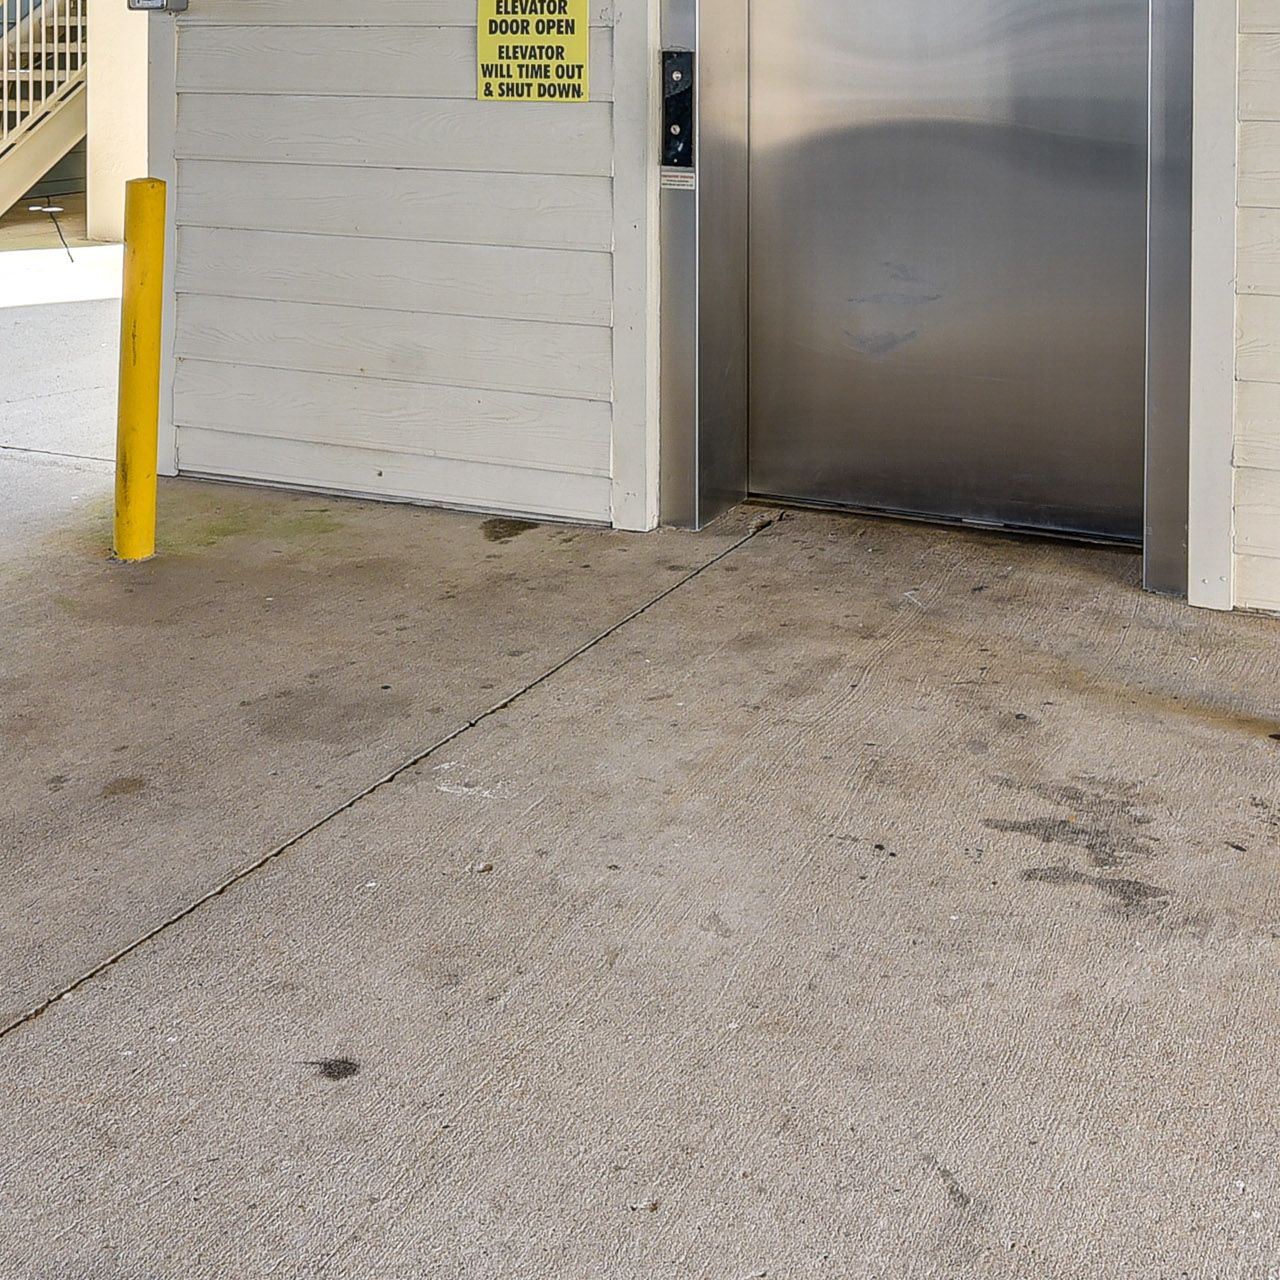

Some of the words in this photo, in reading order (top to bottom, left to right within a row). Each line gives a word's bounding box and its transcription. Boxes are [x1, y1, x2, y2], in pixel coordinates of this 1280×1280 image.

[496, 0, 567, 15] ELEVATOR
[489, 19, 529, 34] DOOR
[535, 19, 575, 34] OPEN
[498, 46, 564, 60] ELEVATOR
[481, 64, 512, 78] WILL
[517, 64, 550, 78] TIME
[555, 65, 583, 79] OUT
[484, 83, 493, 97] &
[499, 83, 532, 97] SHUT
